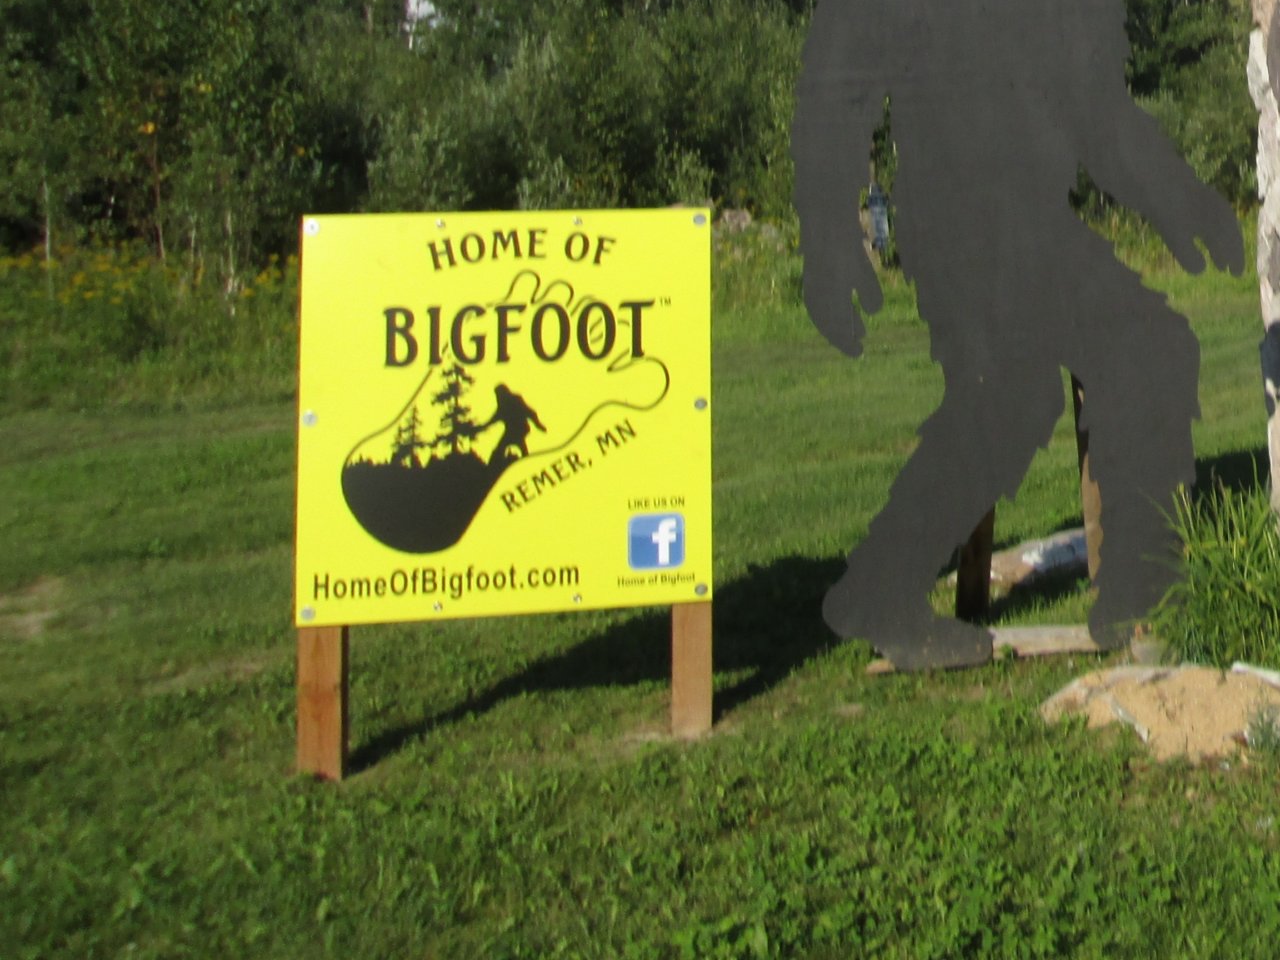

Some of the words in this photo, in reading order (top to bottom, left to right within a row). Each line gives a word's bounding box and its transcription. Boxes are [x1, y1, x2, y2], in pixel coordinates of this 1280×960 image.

[427, 228, 548, 271] HOME
[564, 230, 617, 265] OF
[383, 297, 656, 368] BIGFOOT
[499, 451, 593, 513] REMER,
[596, 418, 637, 456] MN
[627, 497, 650, 510] LIKE
[653, 496, 667, 509] US
[670, 495, 685, 508] ON
[312, 564, 581, 602] HomeOfBigfoot.com
[617, 575, 645, 588] Home
[648, 574, 658, 585] of
[660, 571, 696, 586] Bigfoot
